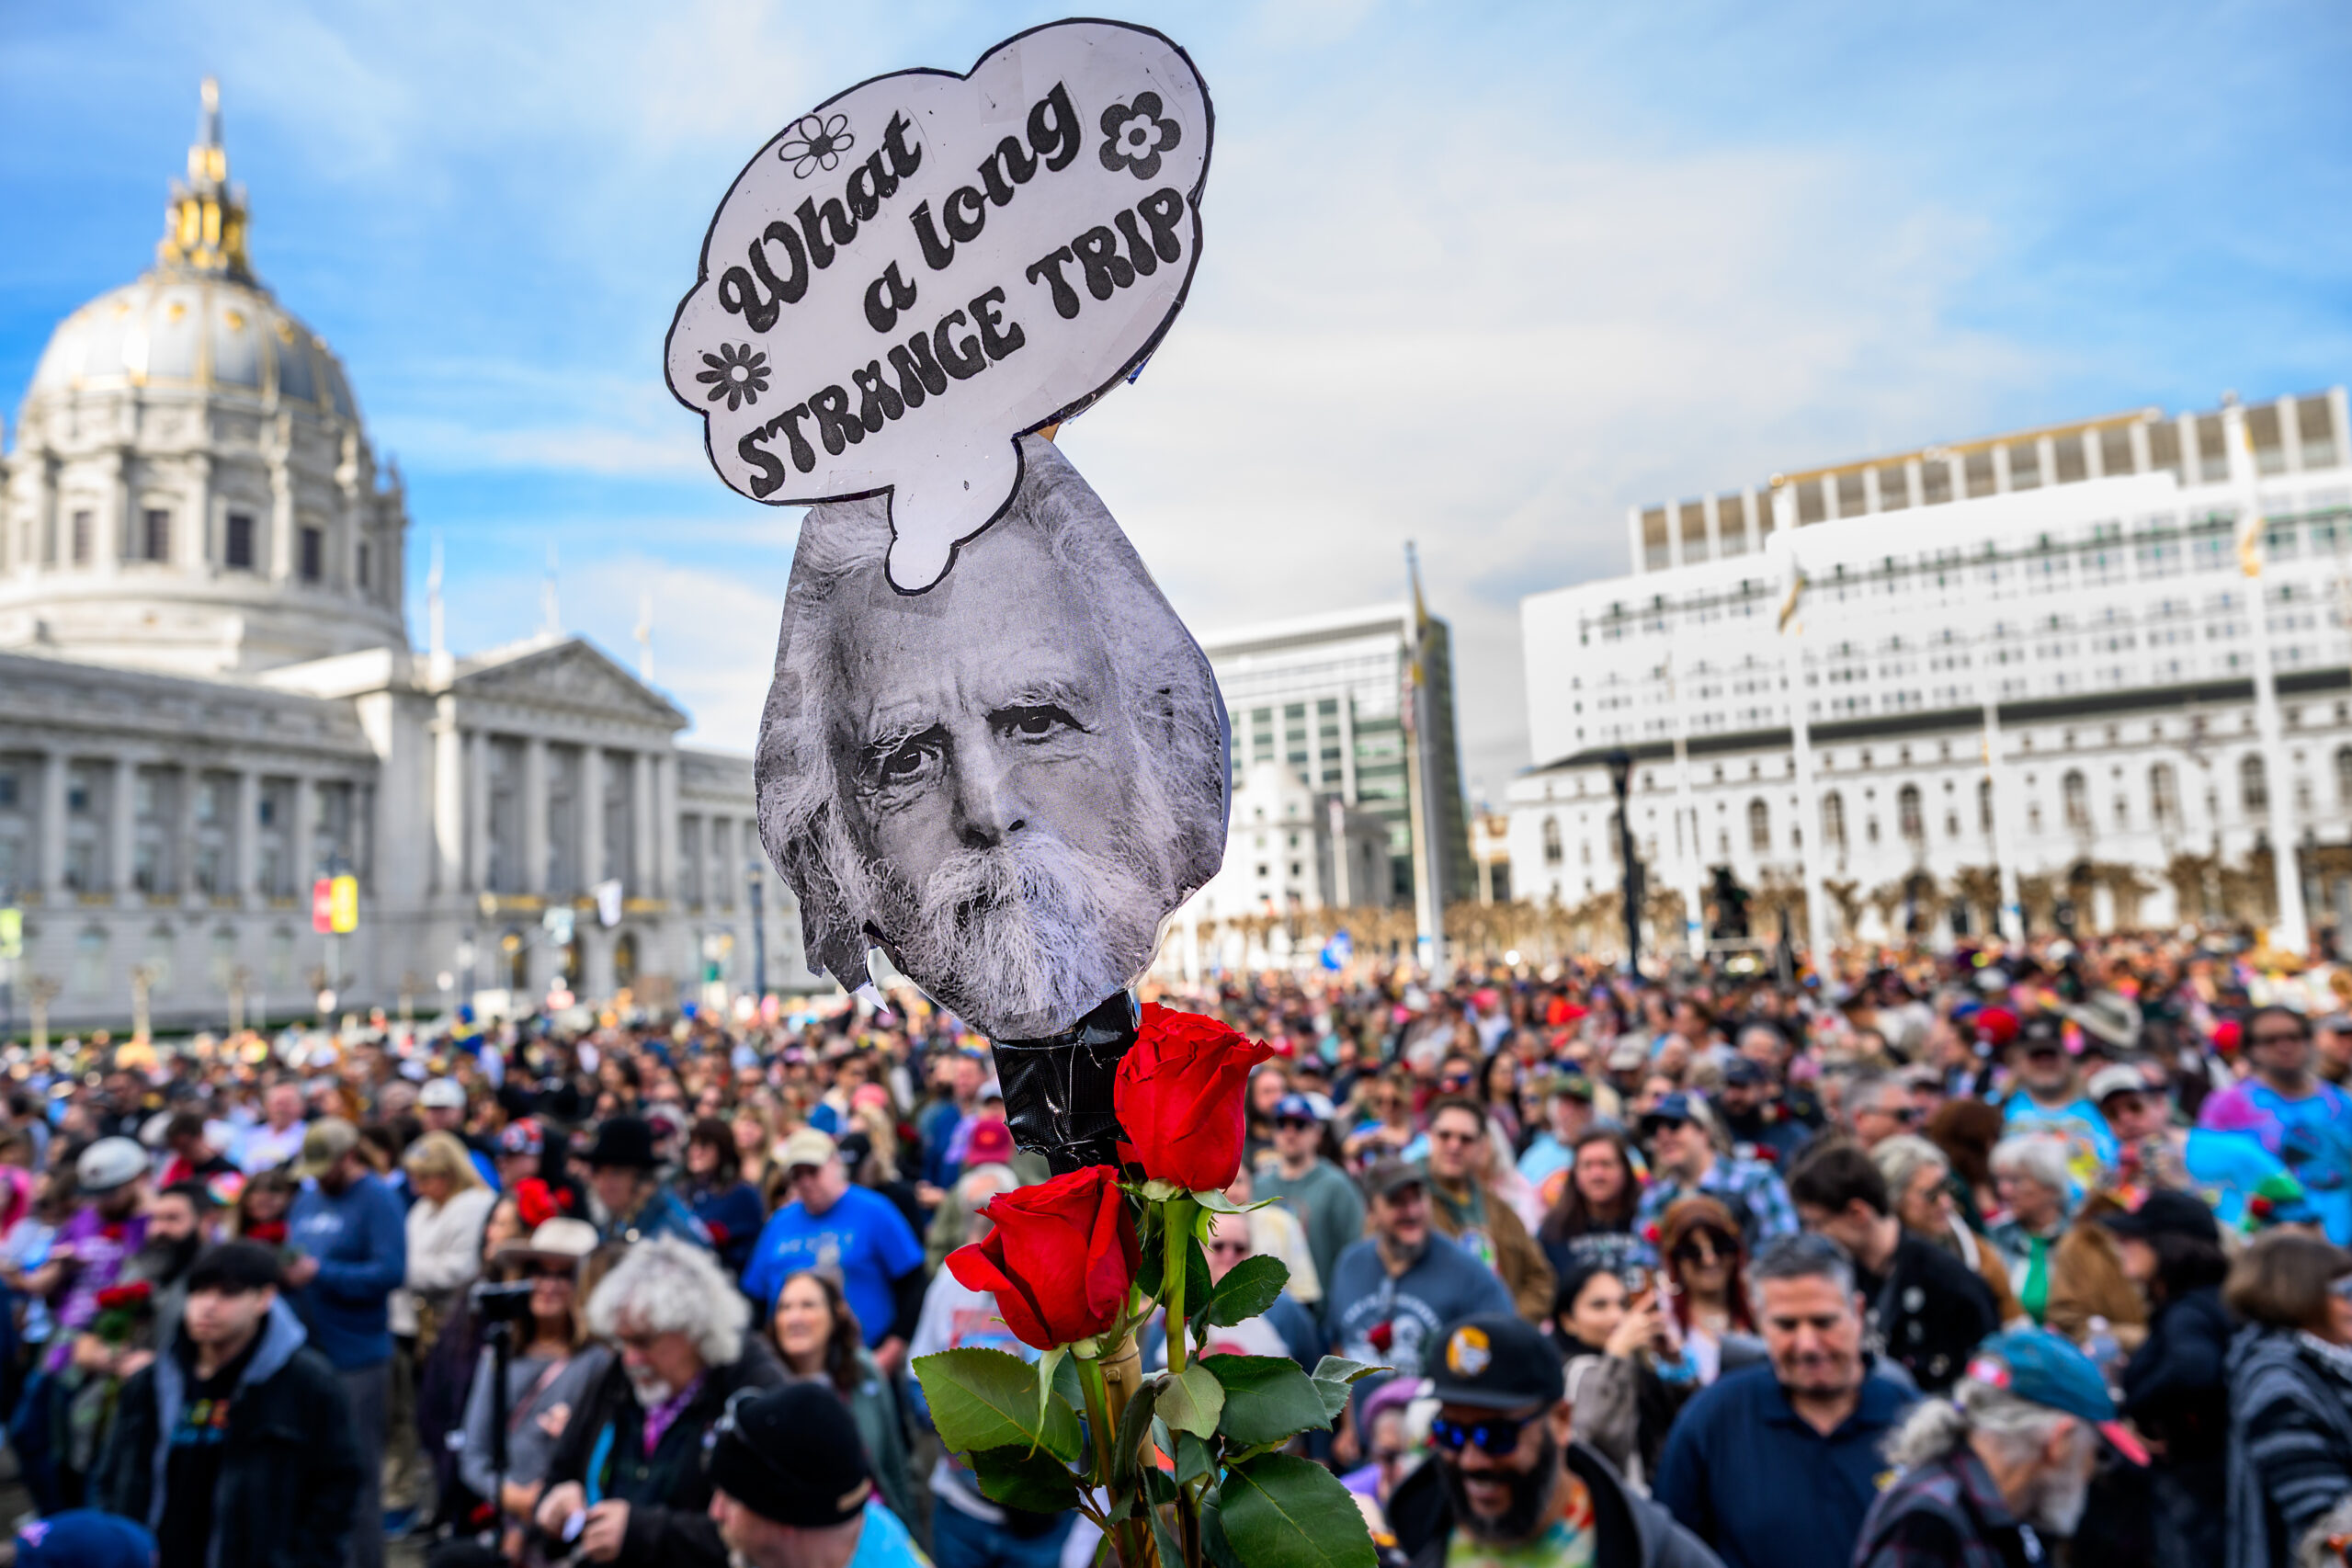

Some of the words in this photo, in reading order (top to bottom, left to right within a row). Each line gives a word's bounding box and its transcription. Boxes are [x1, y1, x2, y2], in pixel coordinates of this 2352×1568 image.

[719, 109, 922, 333] What
[864, 259, 917, 333] a
[909, 81, 1082, 270] long
[738, 286, 1026, 498] STRANGE
[1026, 187, 1184, 320] TRIP
